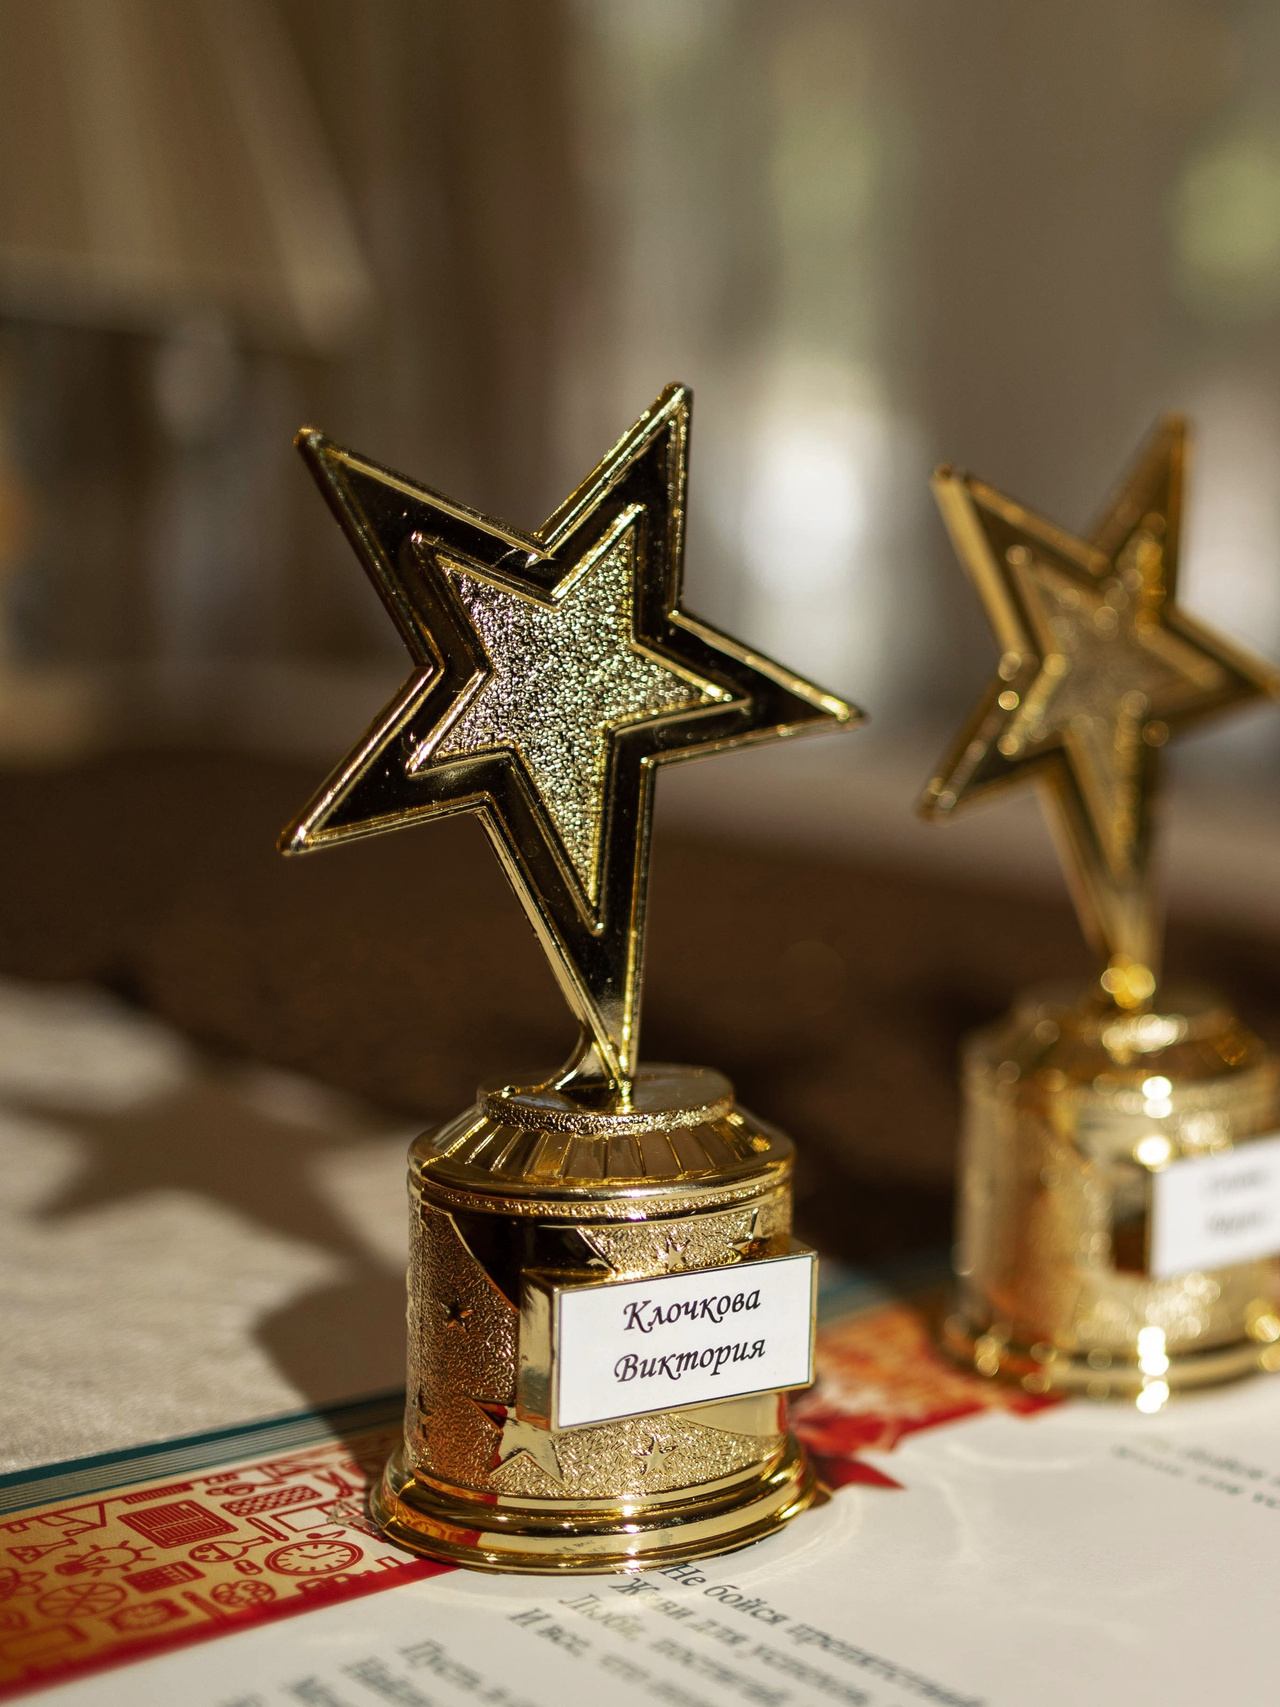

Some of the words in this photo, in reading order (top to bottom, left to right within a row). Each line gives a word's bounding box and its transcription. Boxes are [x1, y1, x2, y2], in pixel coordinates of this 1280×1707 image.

[623, 1289, 761, 1333] Клочкова
[613, 1338, 766, 1383] Виктория
[658, 1563, 707, 1587] Не
[702, 1584, 790, 1627] бойся
